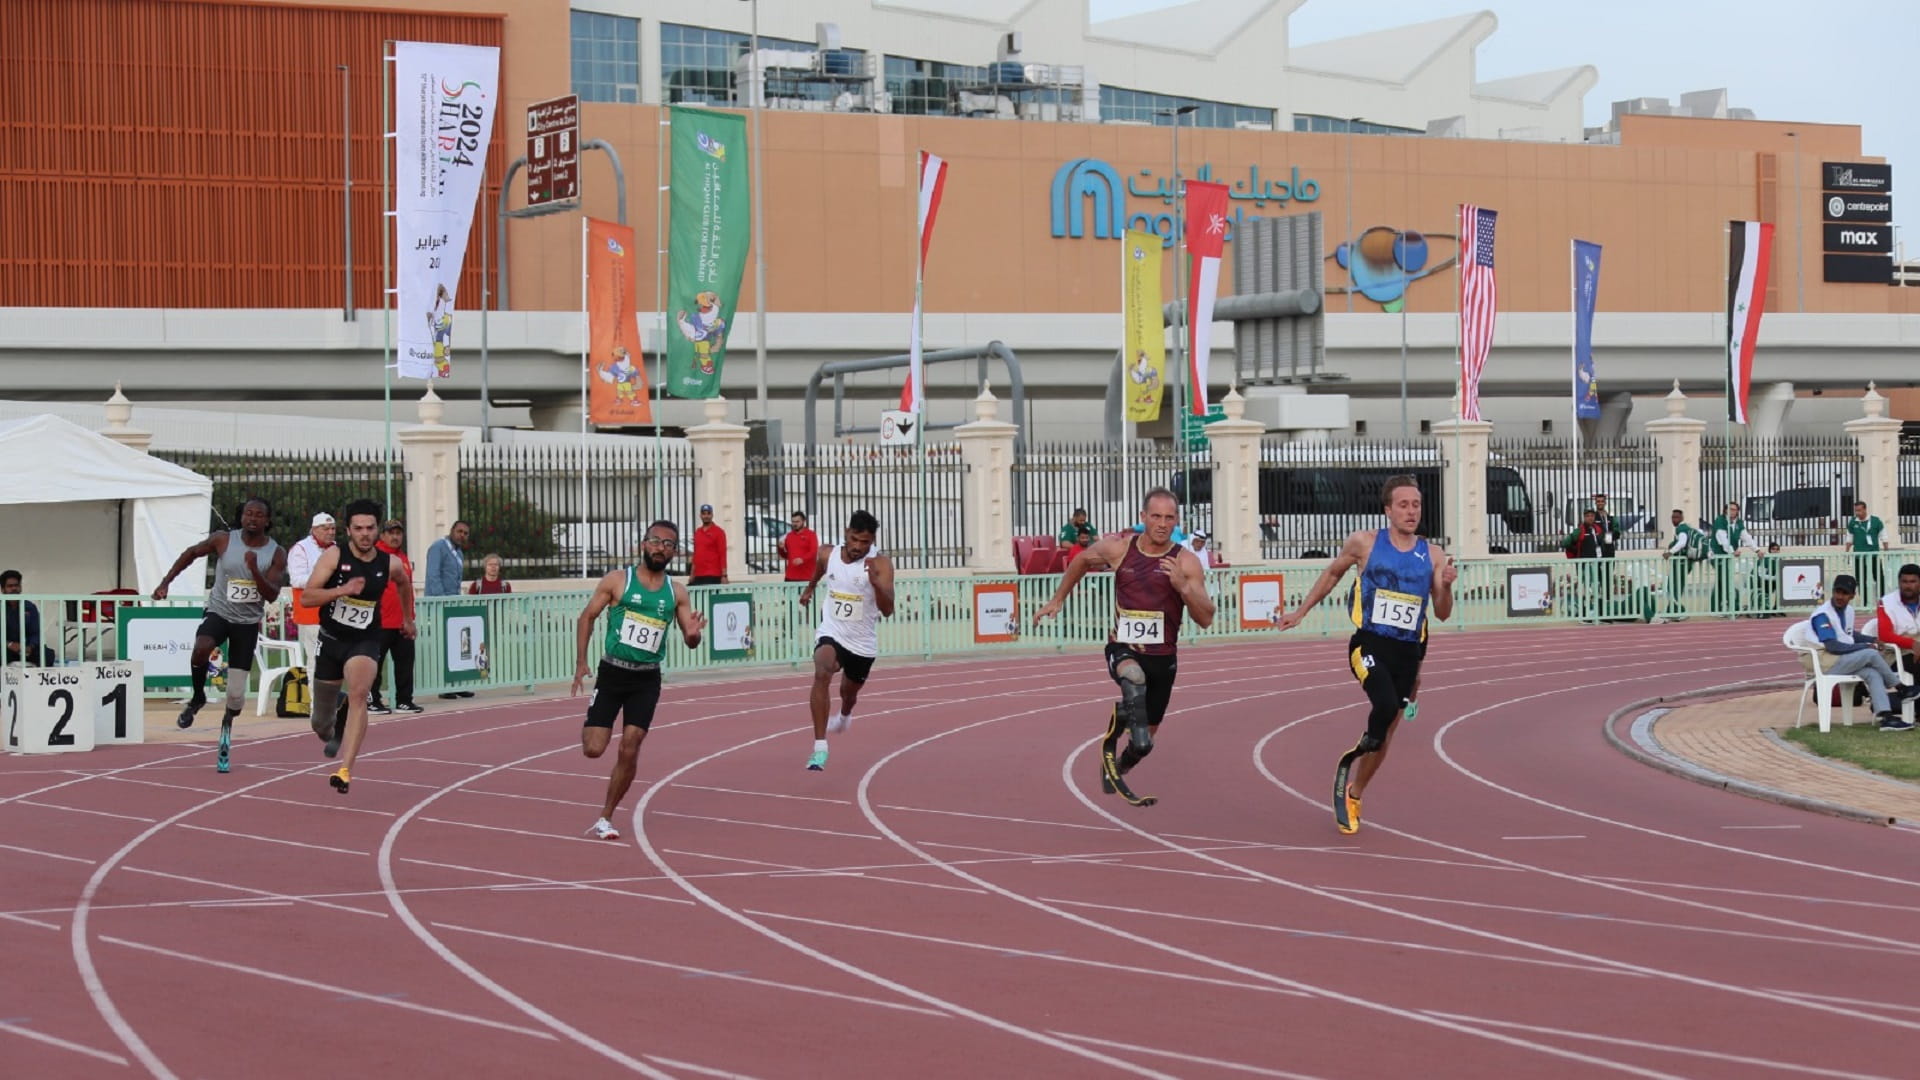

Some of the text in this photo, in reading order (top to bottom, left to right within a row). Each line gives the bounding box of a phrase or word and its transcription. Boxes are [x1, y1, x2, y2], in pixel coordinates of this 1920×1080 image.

[438, 79, 481, 196] SHARJ
[452, 103, 483, 167] 2024
[1229, 164, 1321, 208] ماجيك
[1847, 202, 1889, 213] centrepoint
[1840, 231, 1878, 245] max
[231, 586, 259, 600] 293
[341, 606, 369, 624] 129
[834, 601, 853, 618] 79
[1380, 602, 1416, 625] 155
[628, 624, 660, 648] 181
[1124, 621, 1159, 639] 194
[8, 690, 18, 746] 2
[47, 688, 75, 746] 2
[101, 683, 127, 738] 1
